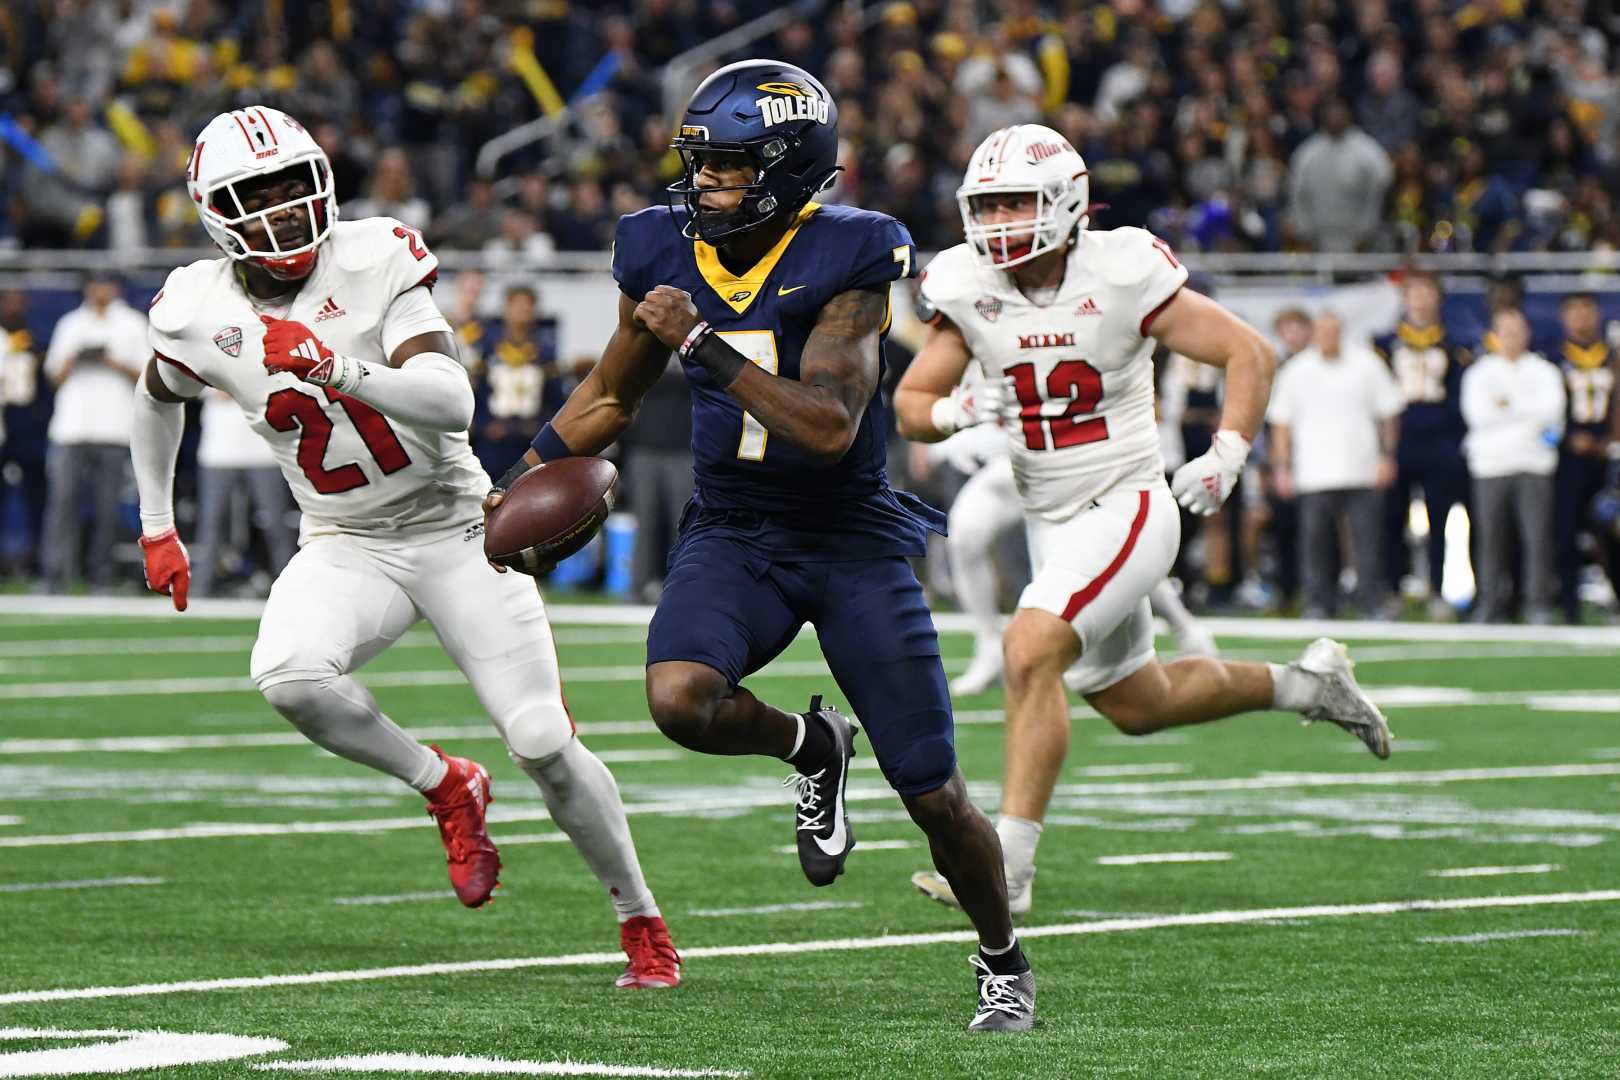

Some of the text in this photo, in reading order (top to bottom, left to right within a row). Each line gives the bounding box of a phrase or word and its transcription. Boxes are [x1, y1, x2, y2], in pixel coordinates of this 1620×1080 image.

[756, 94, 828, 127] TOLEDO
[892, 245, 911, 279] 7
[1018, 332, 1075, 348] MIAMI
[1004, 360, 1108, 450] 12
[265, 386, 412, 494] 21
